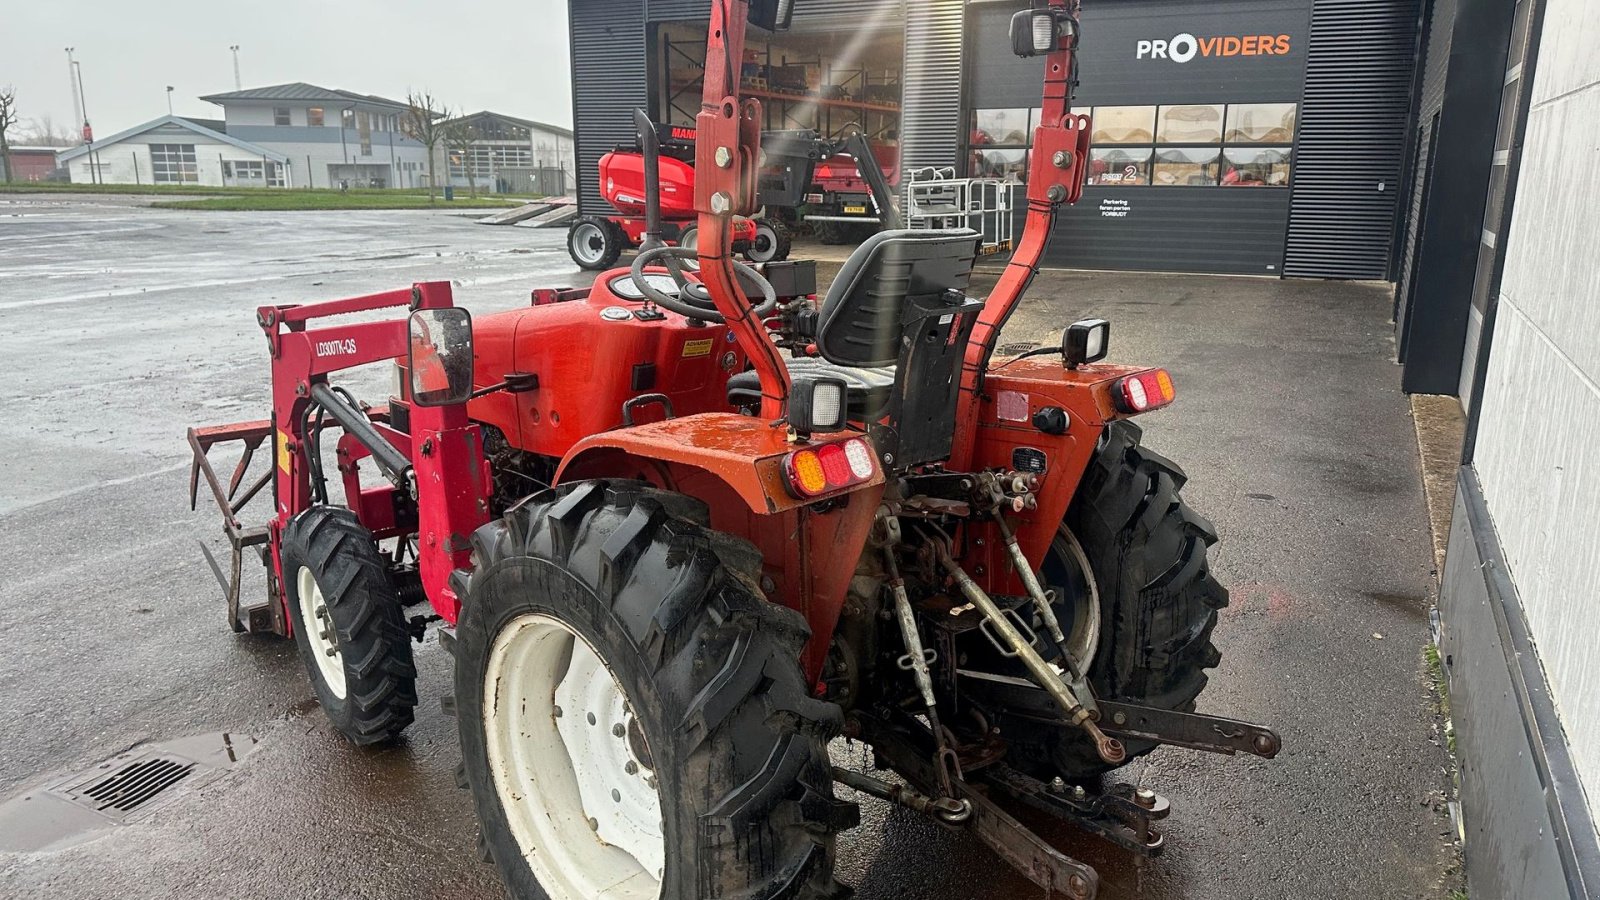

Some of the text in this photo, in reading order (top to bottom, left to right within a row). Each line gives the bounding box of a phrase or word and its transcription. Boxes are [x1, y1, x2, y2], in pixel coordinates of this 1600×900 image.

[1136, 33, 1290, 63] PROVIDERS
[671, 127, 696, 139] MANI
[1101, 165, 1137, 181] PORT 2
